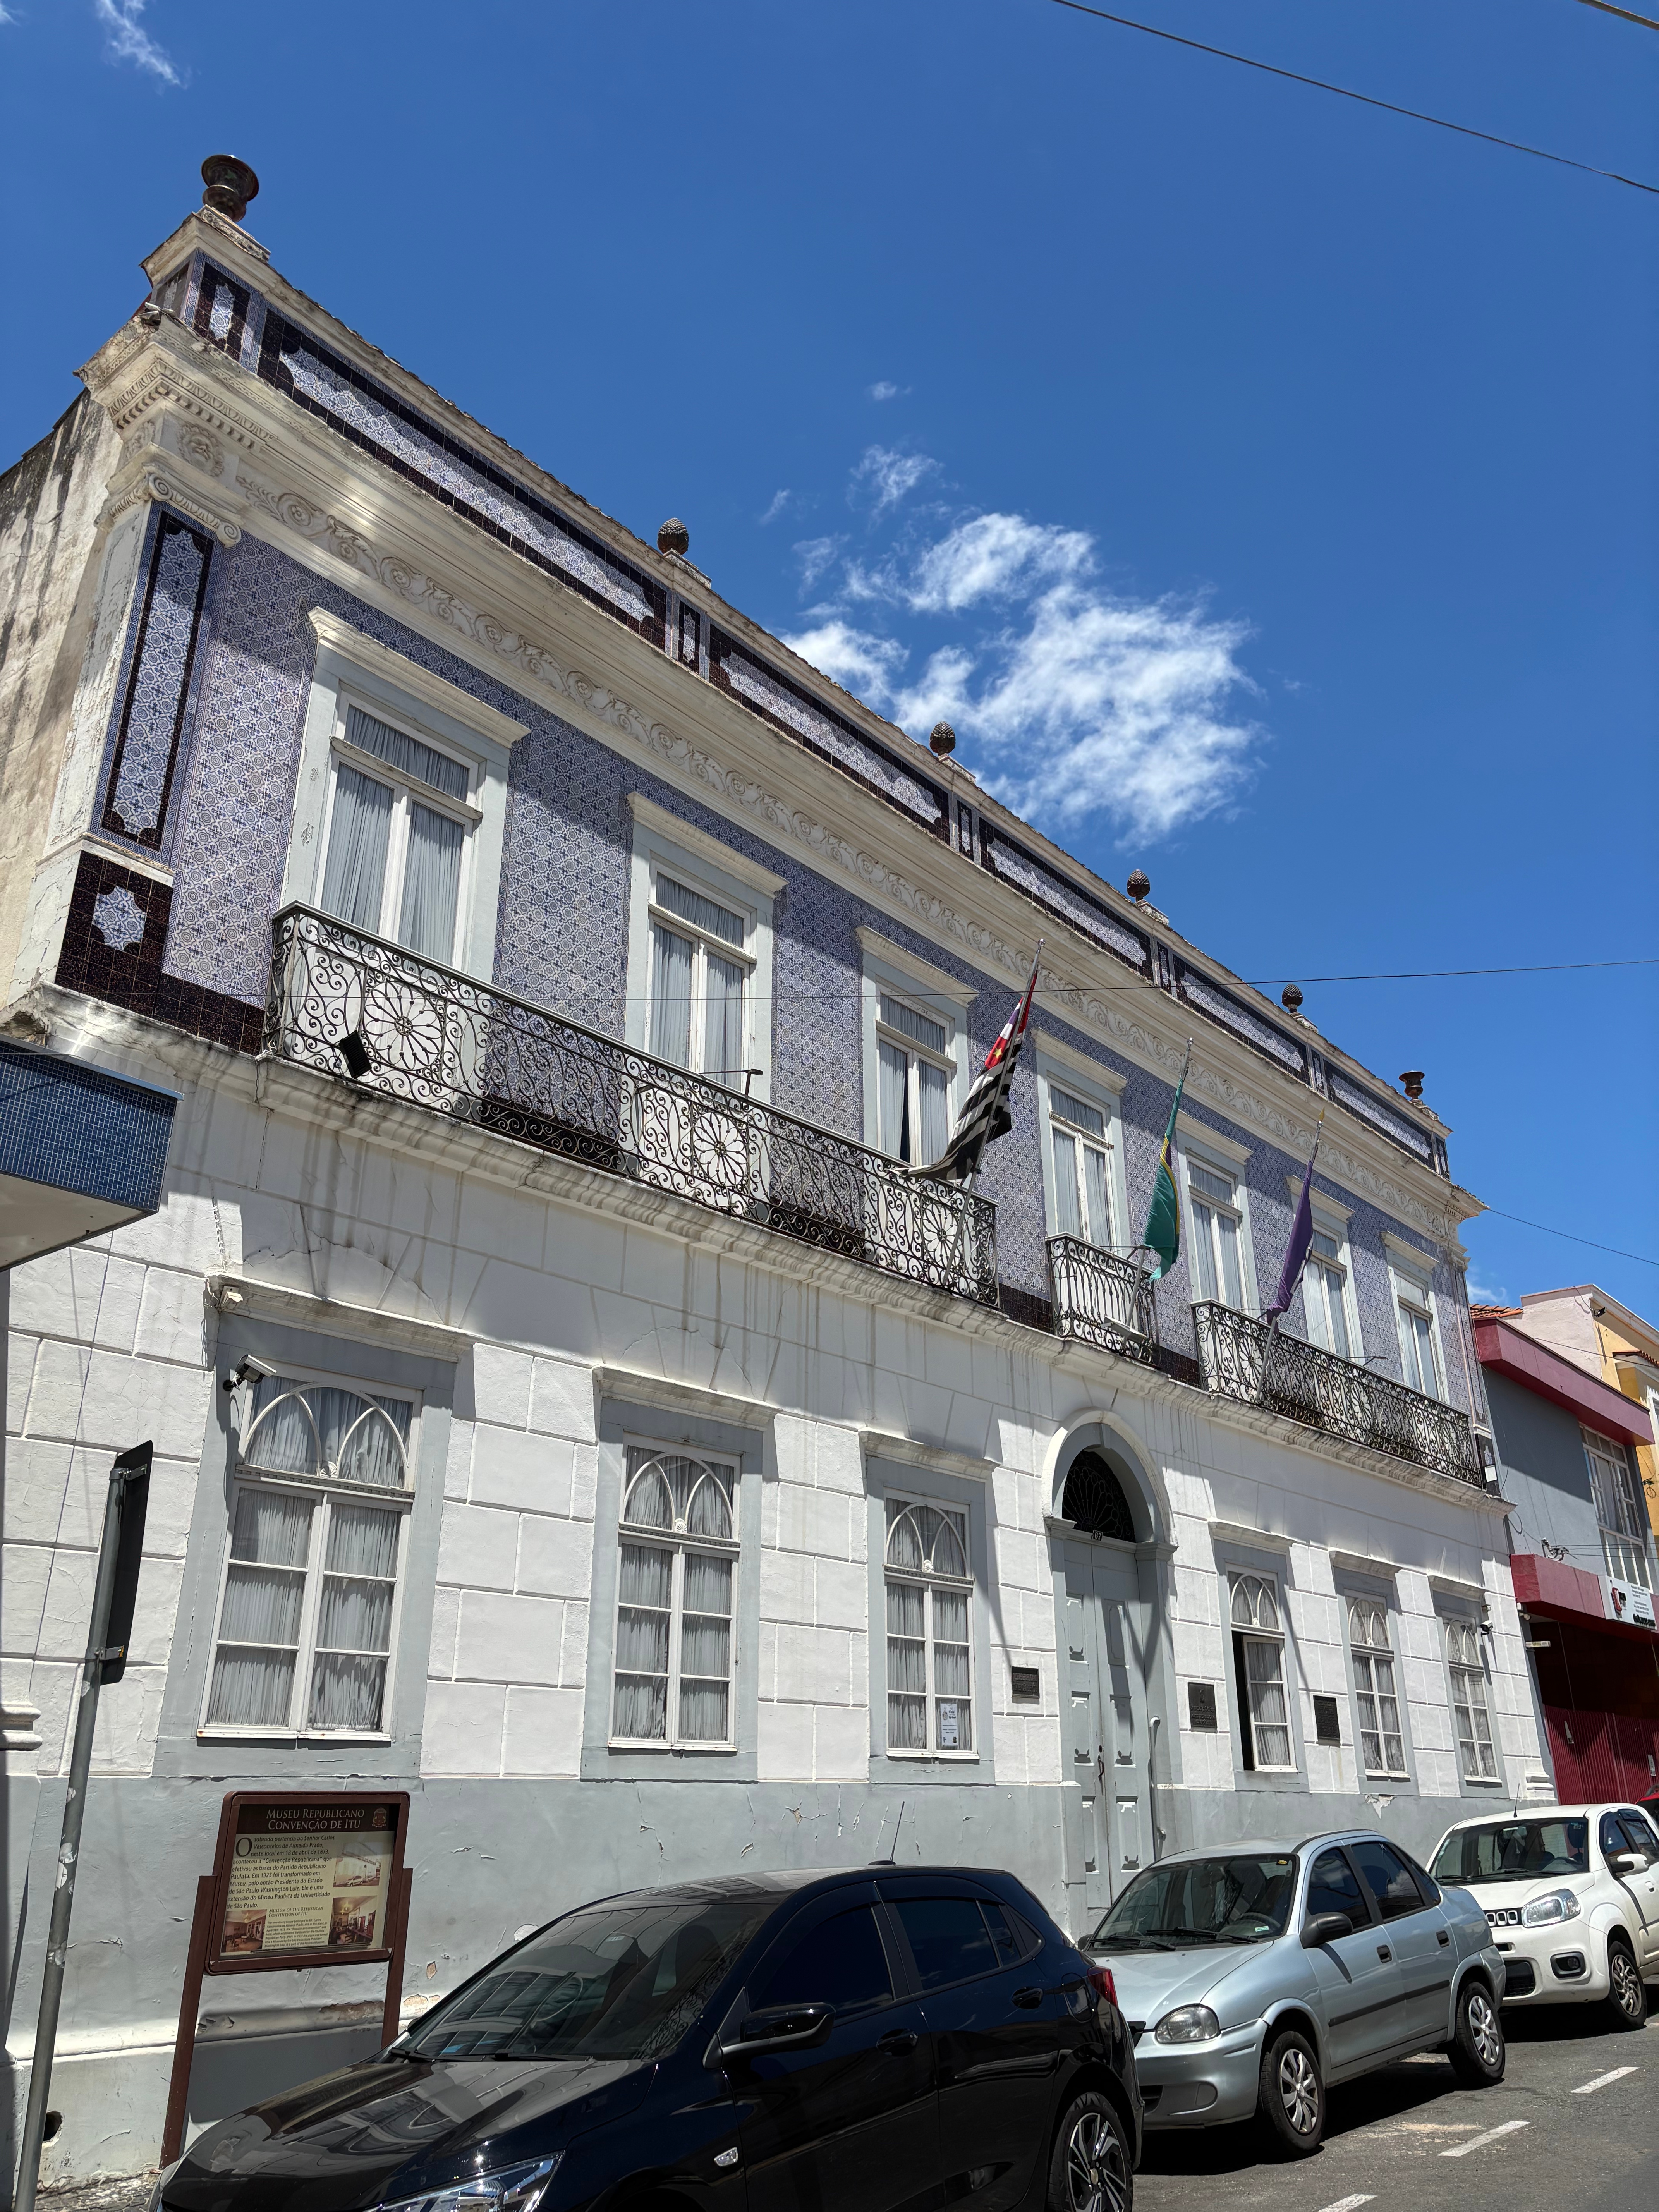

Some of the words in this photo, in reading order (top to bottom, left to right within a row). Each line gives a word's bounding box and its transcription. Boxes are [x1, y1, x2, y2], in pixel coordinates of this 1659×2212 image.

[266, 1809, 299, 1819] MUSEU
[303, 1809, 364, 1818] REPUBLICANO
[268, 1819, 327, 1831] CONVENÇÃO
[345, 1819, 360, 1828] ITU
